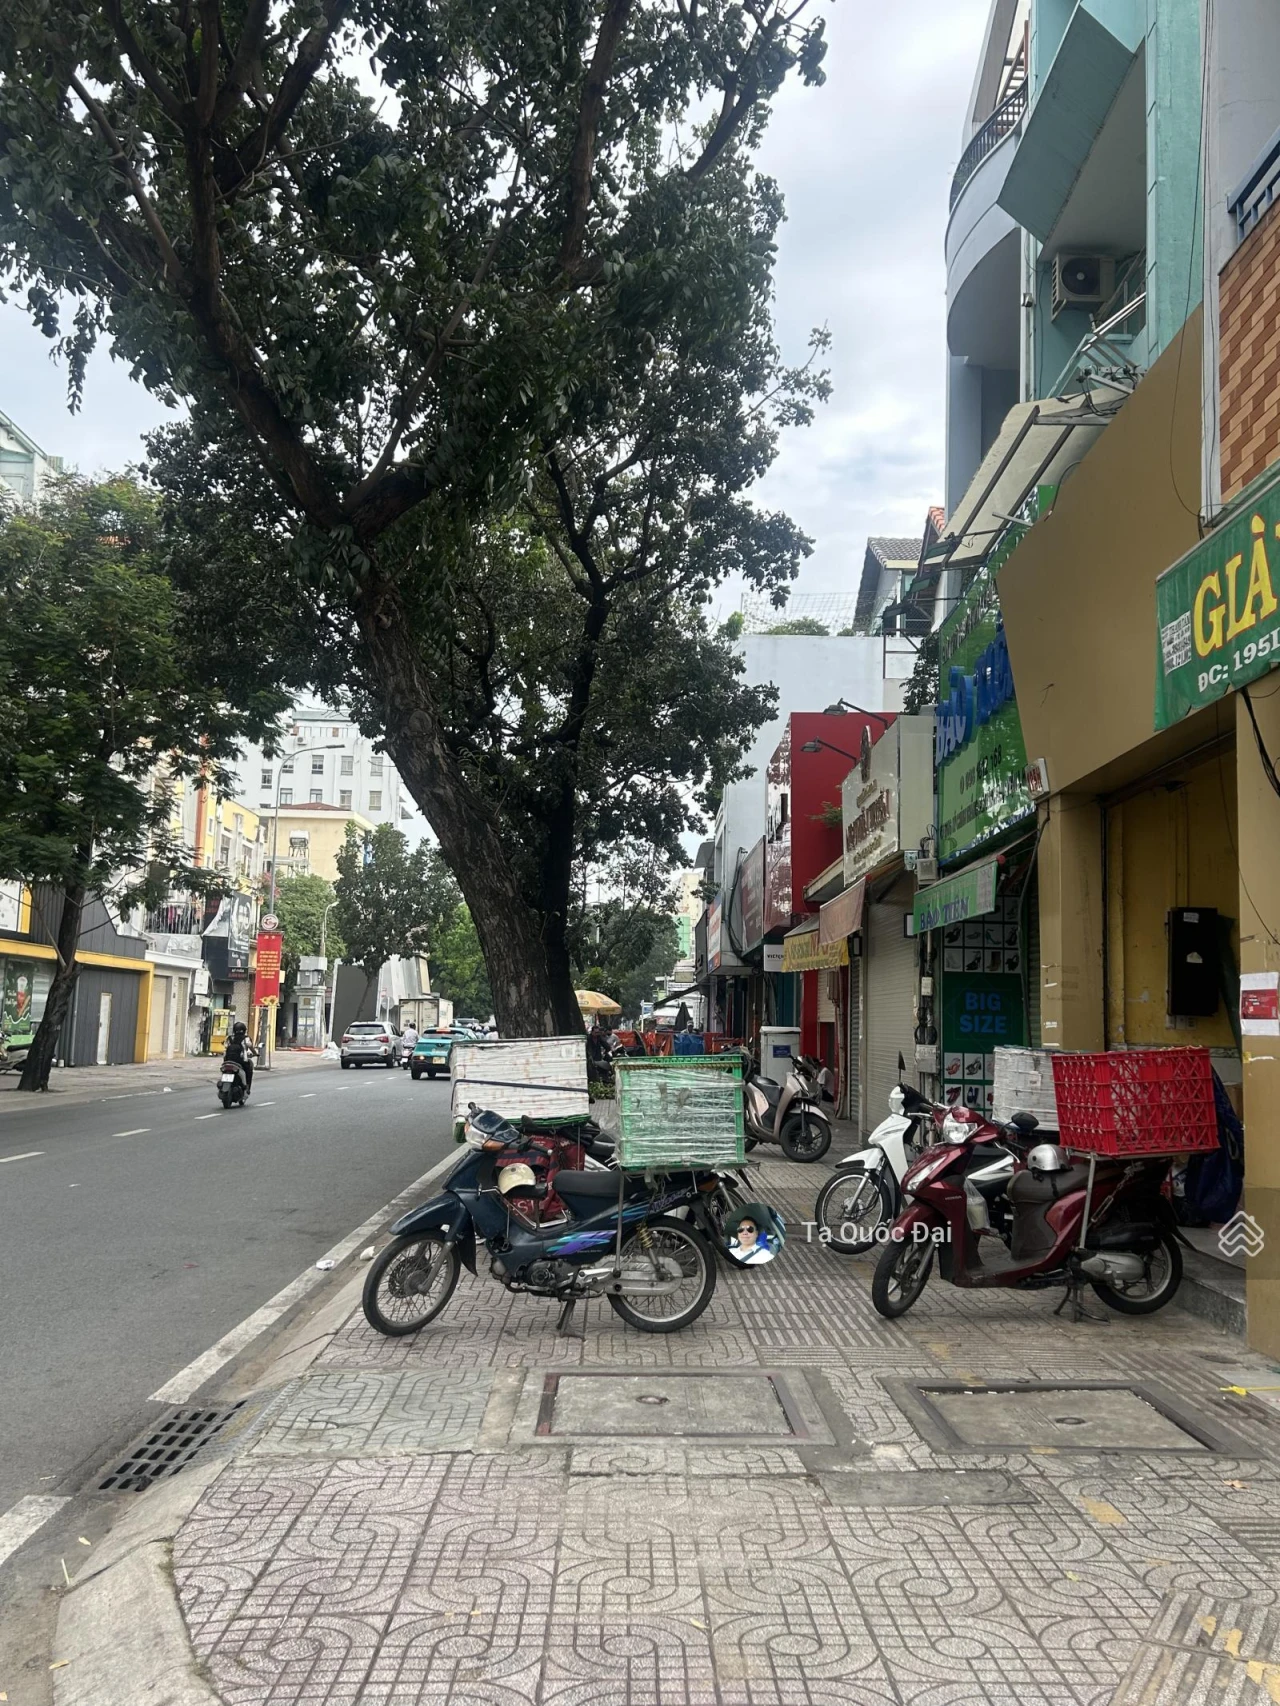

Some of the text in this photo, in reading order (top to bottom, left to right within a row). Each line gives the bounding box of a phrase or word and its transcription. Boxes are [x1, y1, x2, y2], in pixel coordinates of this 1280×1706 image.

[1193, 514, 1280, 658] GIÀ
[1198, 664, 1229, 693] ĐC:
[965, 991, 1001, 1011] BIG
[959, 1014, 1007, 1034] SIZE
